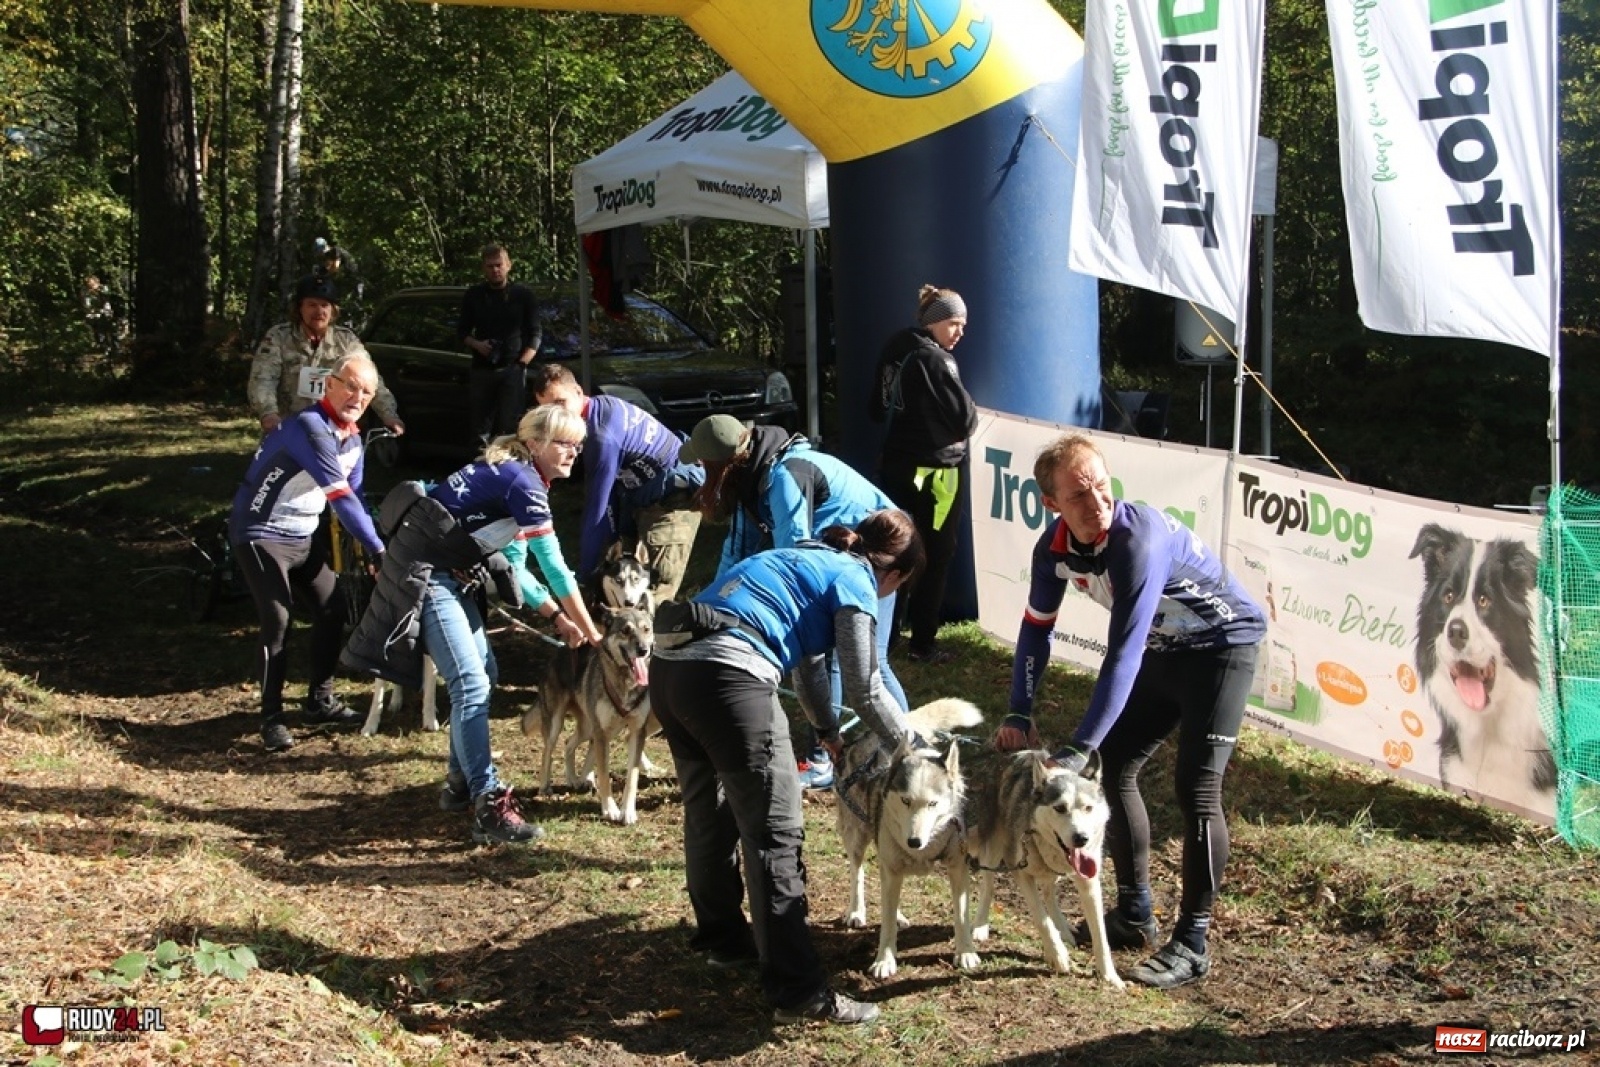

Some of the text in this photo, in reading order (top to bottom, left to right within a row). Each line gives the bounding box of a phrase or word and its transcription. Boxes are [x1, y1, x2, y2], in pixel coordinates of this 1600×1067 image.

[647, 95, 789, 142] TropiDog
[593, 177, 656, 214] TropiDog
[696, 178, 782, 204] www.tropidog.pl
[250, 466, 285, 513] POLAREX
[1238, 471, 1374, 559] TropiDog
[1025, 655, 1036, 699] POLAREX
